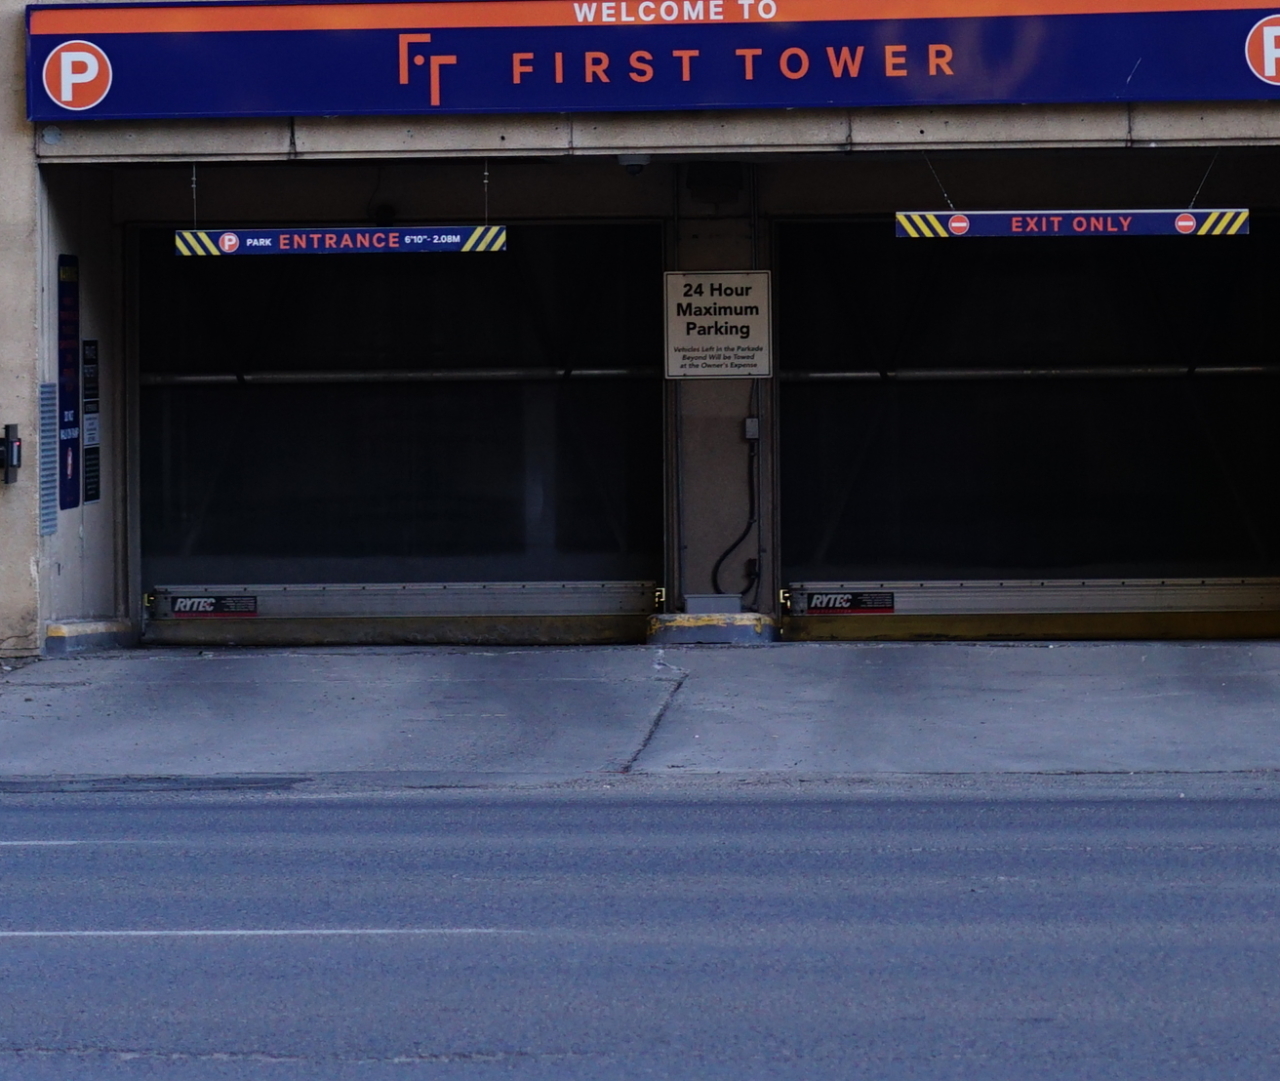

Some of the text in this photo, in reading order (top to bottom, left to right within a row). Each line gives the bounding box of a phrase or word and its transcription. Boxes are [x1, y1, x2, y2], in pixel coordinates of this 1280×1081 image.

[573, 0, 724, 24] WELCOME
[511, 43, 955, 85] FIRST TOWER
[60, 51, 100, 103] P
[1011, 216, 1133, 233] EXIT ONLY
[223, 235, 237, 250] P
[245, 237, 273, 248] PARK
[279, 232, 400, 250] ENTRANCE
[682, 282, 752, 298] 24 Hour
[676, 302, 759, 317] Maximum
[685, 321, 750, 339] Parking
[682, 354, 707, 362] Beyond
[730, 362, 757, 370] Expense
[174, 597, 216, 612] RYTEC
[810, 594, 852, 608] RYTEC
